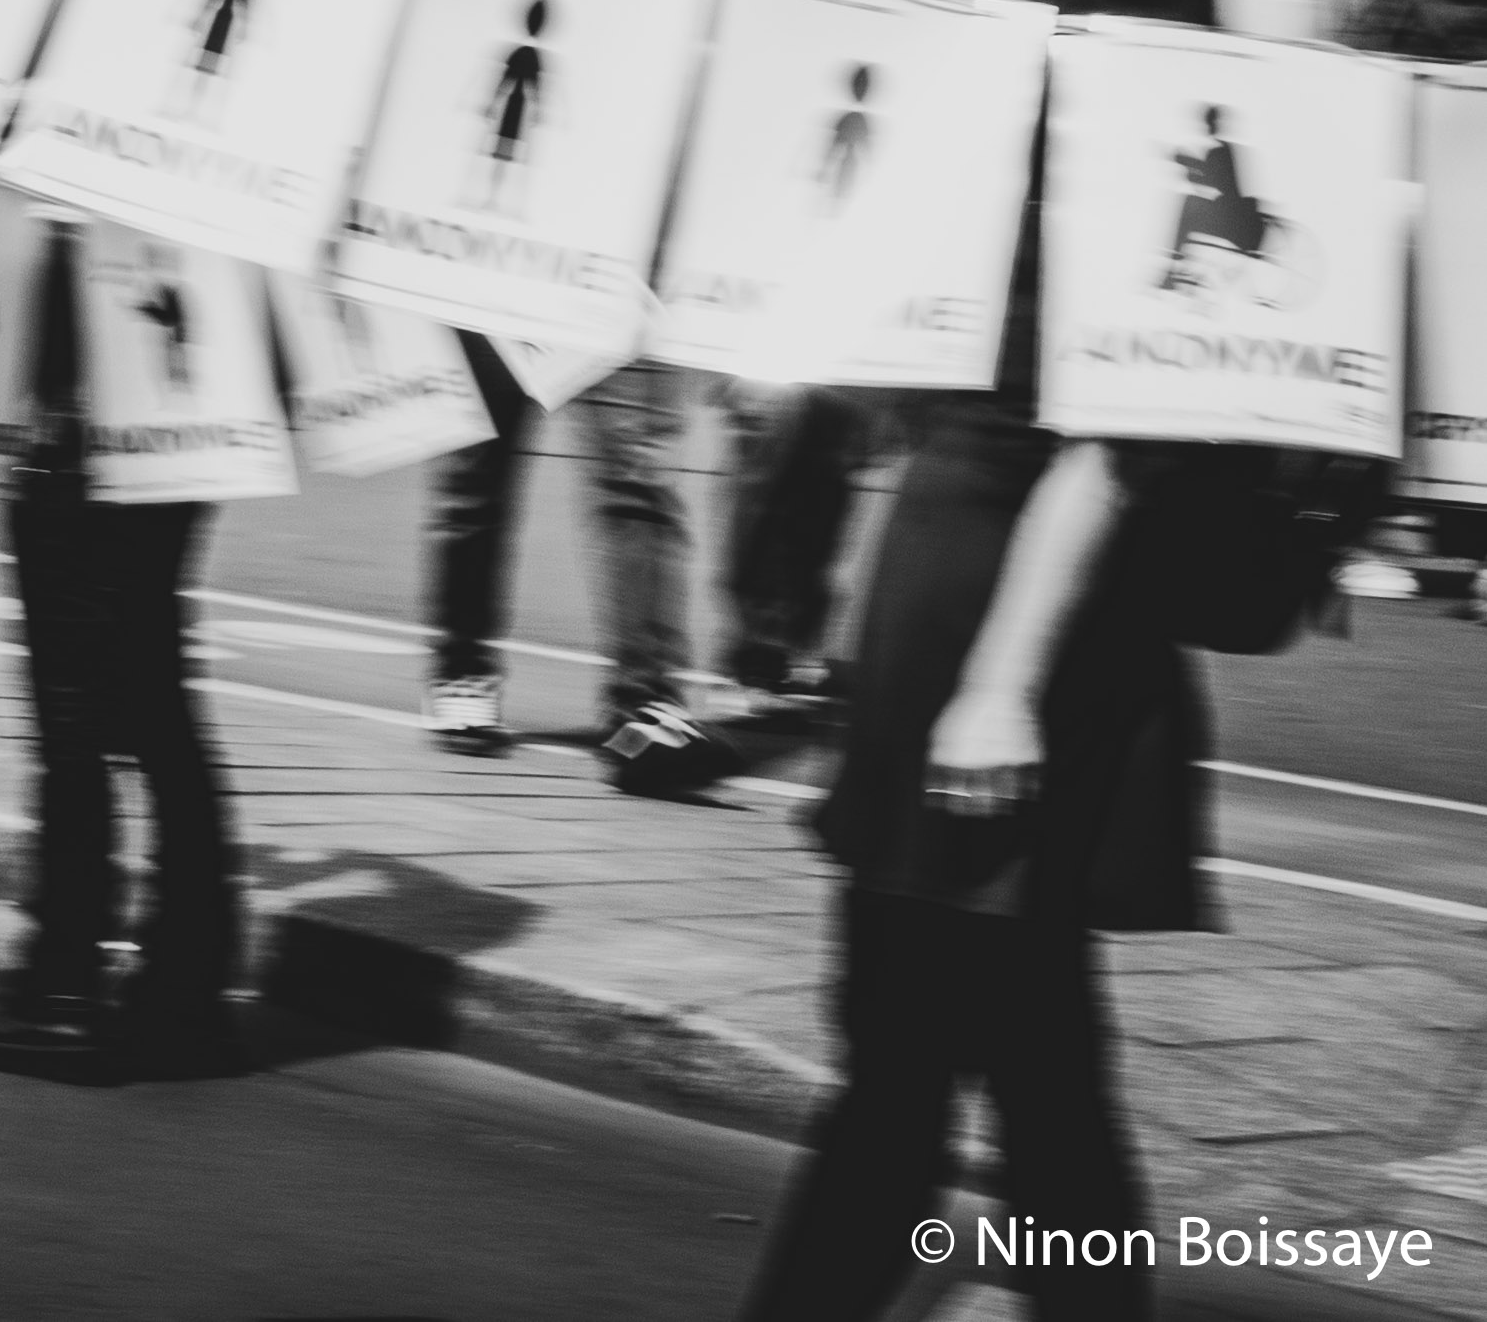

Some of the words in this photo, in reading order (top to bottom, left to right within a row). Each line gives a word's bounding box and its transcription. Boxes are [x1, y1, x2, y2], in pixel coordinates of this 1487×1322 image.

[48, 107, 322, 213] ANONYME
[340, 197, 638, 297] ANONYME
[1070, 327, 1390, 395] ANONYME
